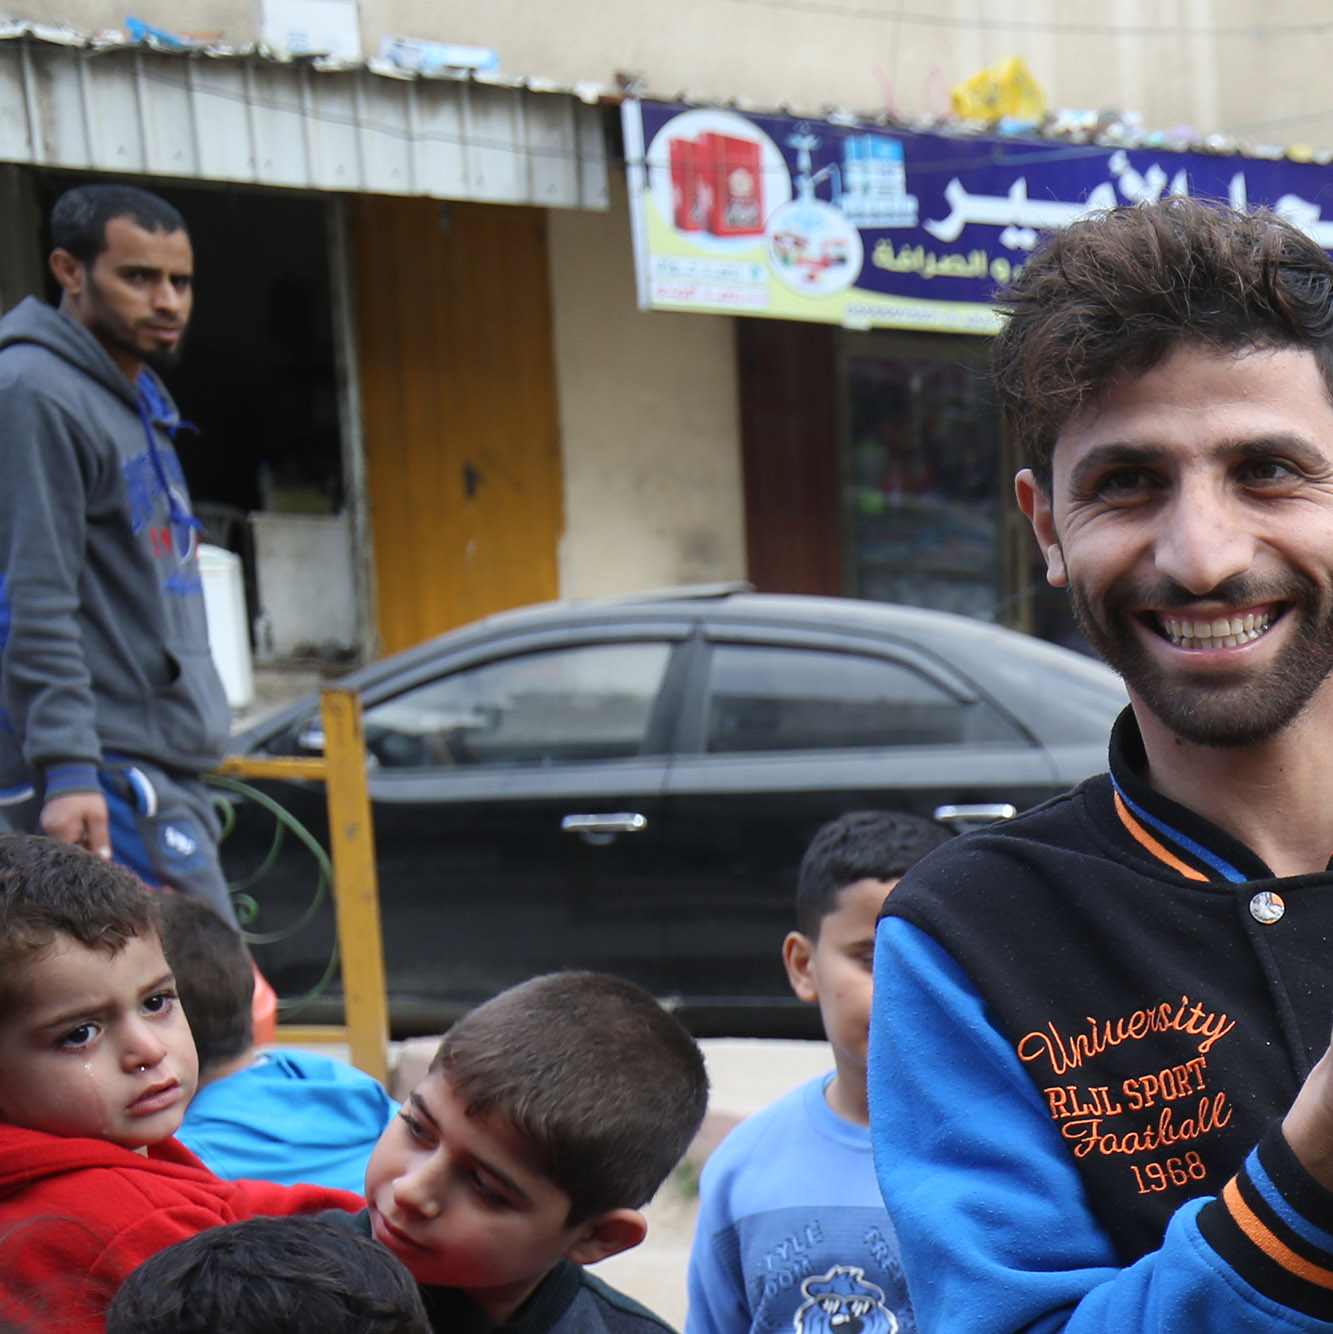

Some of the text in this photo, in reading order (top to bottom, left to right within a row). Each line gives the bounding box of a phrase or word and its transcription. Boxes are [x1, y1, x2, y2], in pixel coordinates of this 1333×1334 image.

[1017, 996, 1236, 1075] University
[1122, 1056, 1208, 1111] SPORT
[1130, 1150, 1208, 1195] 1968
